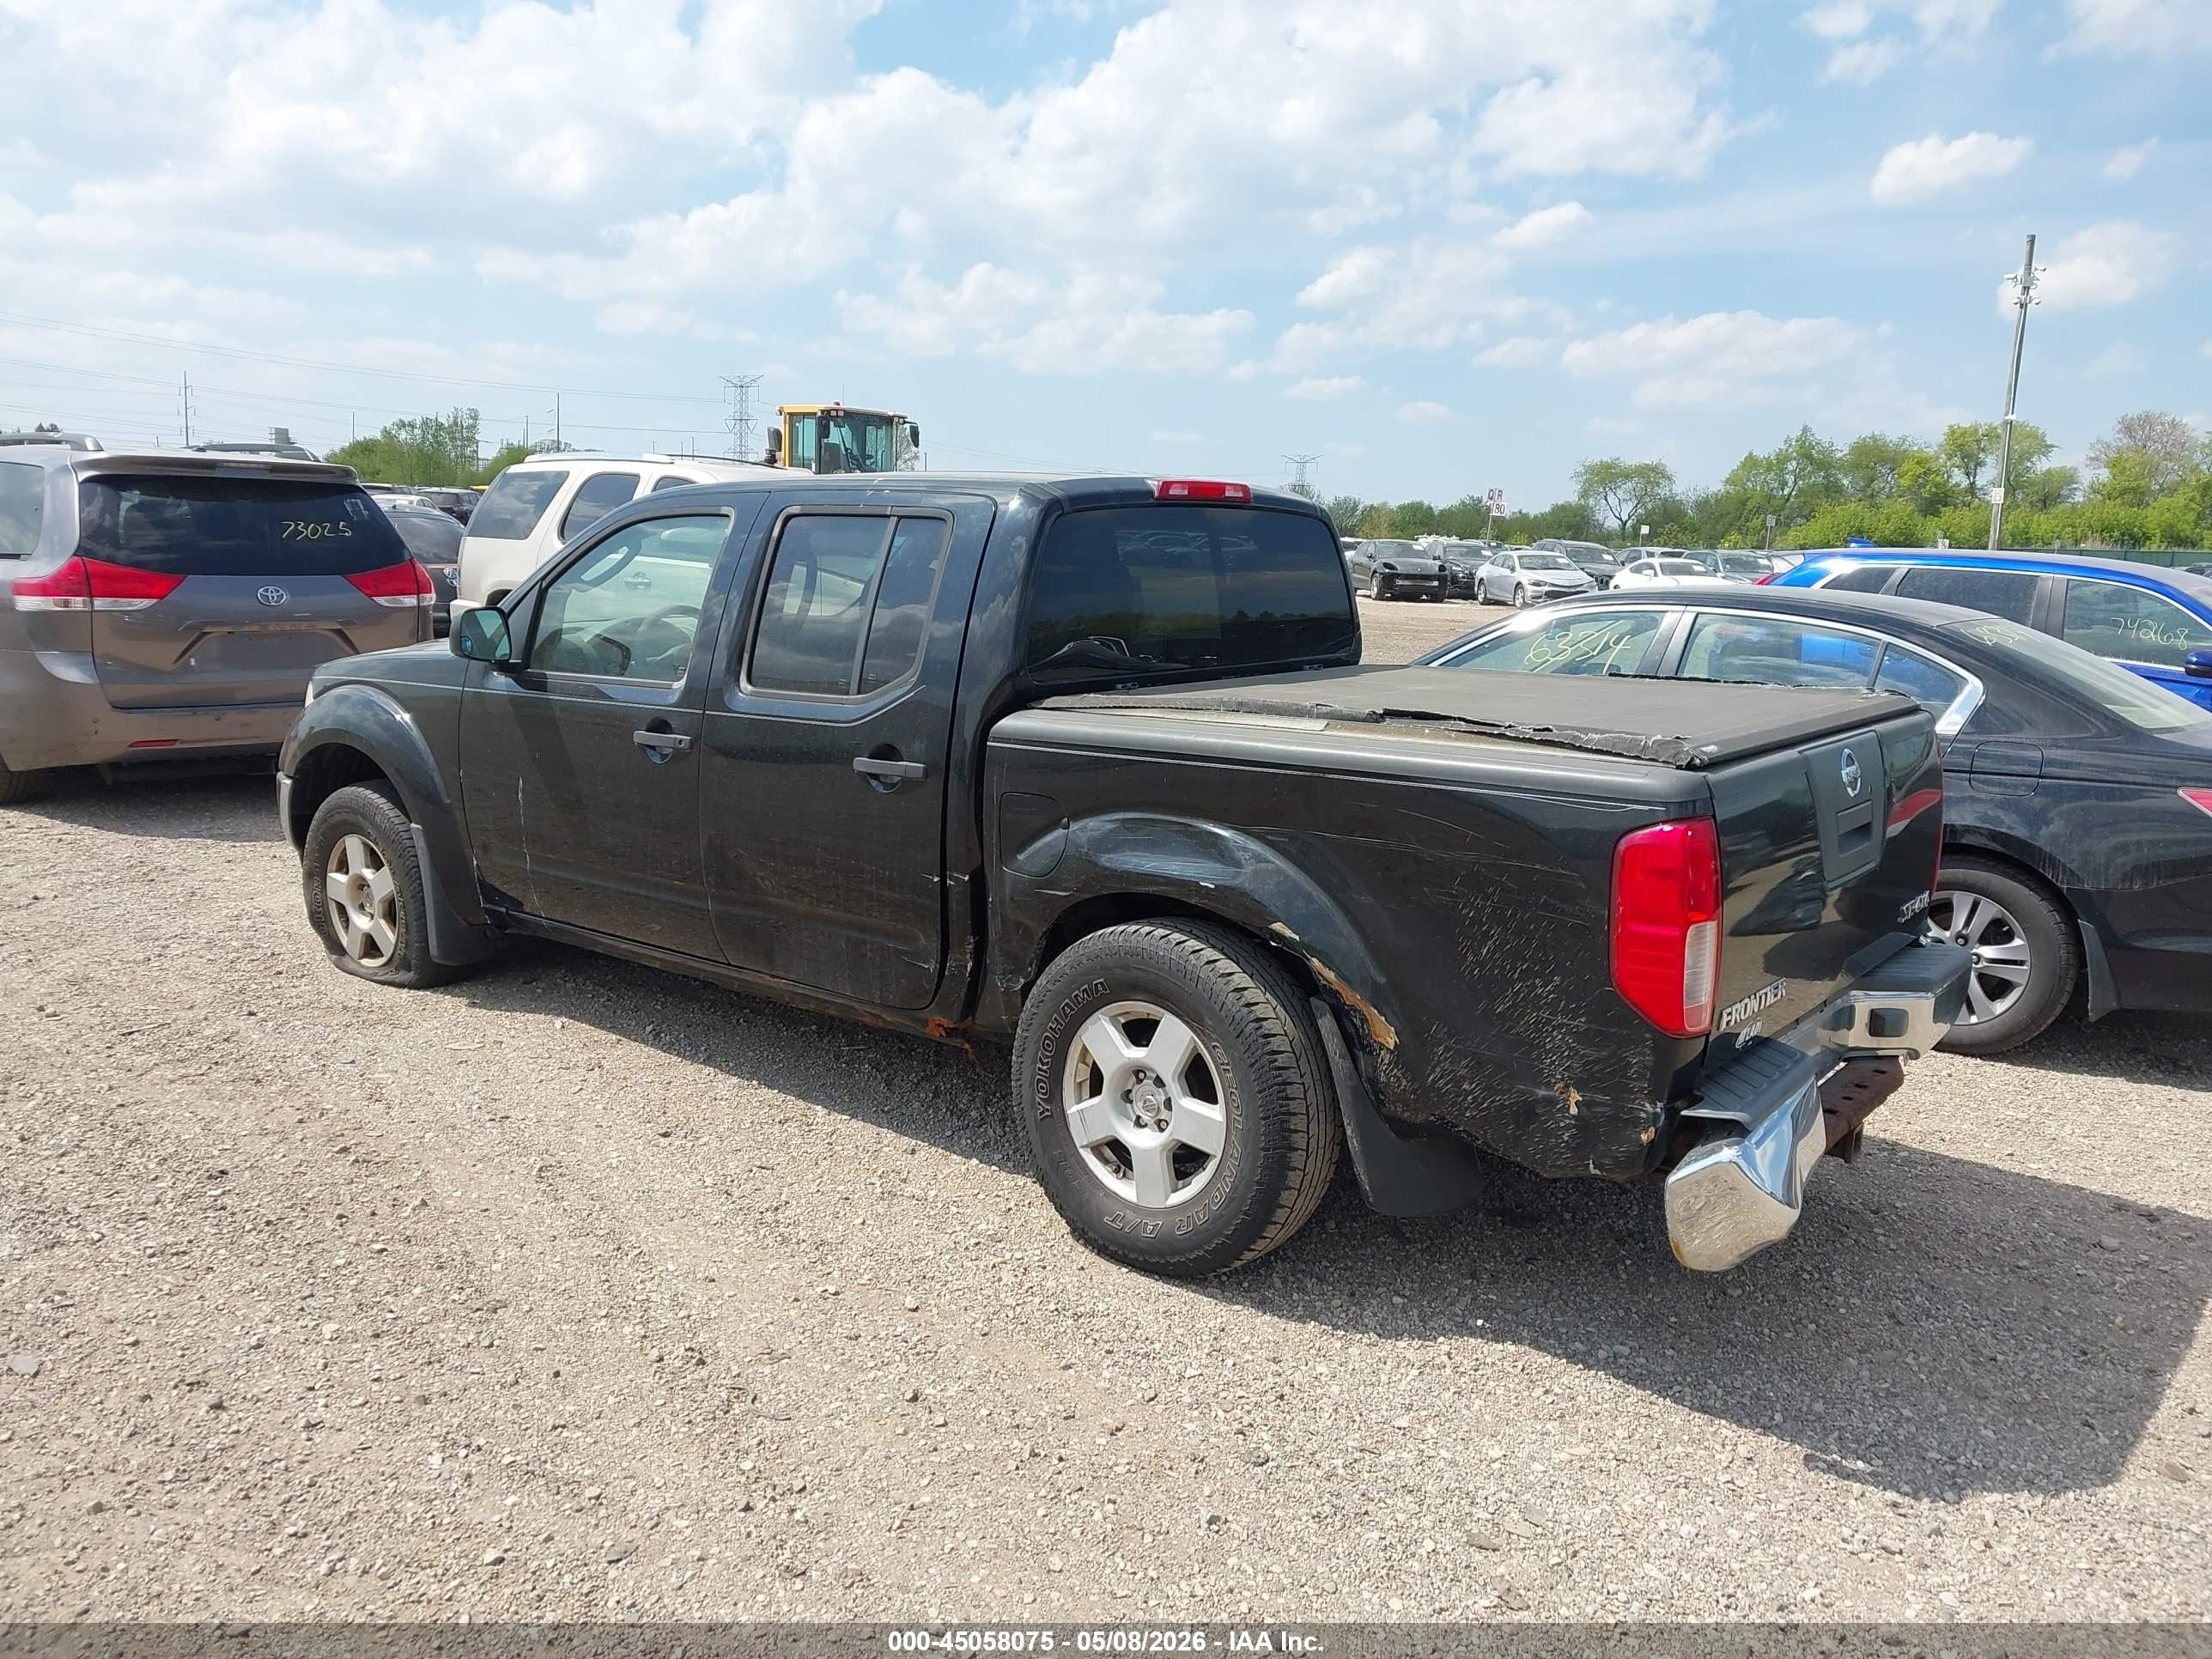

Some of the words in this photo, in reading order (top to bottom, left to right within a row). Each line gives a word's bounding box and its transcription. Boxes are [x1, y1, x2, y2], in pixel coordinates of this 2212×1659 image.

[282, 521, 351, 540] 73025
[1524, 631, 1632, 676] 63314
[2110, 617, 2189, 651] 74268
[1719, 977, 1787, 1031] FRONTIER
[1034, 978, 1110, 1120] YOKOHAMA
[1176, 1042, 1243, 1235] GEOLANDAR
